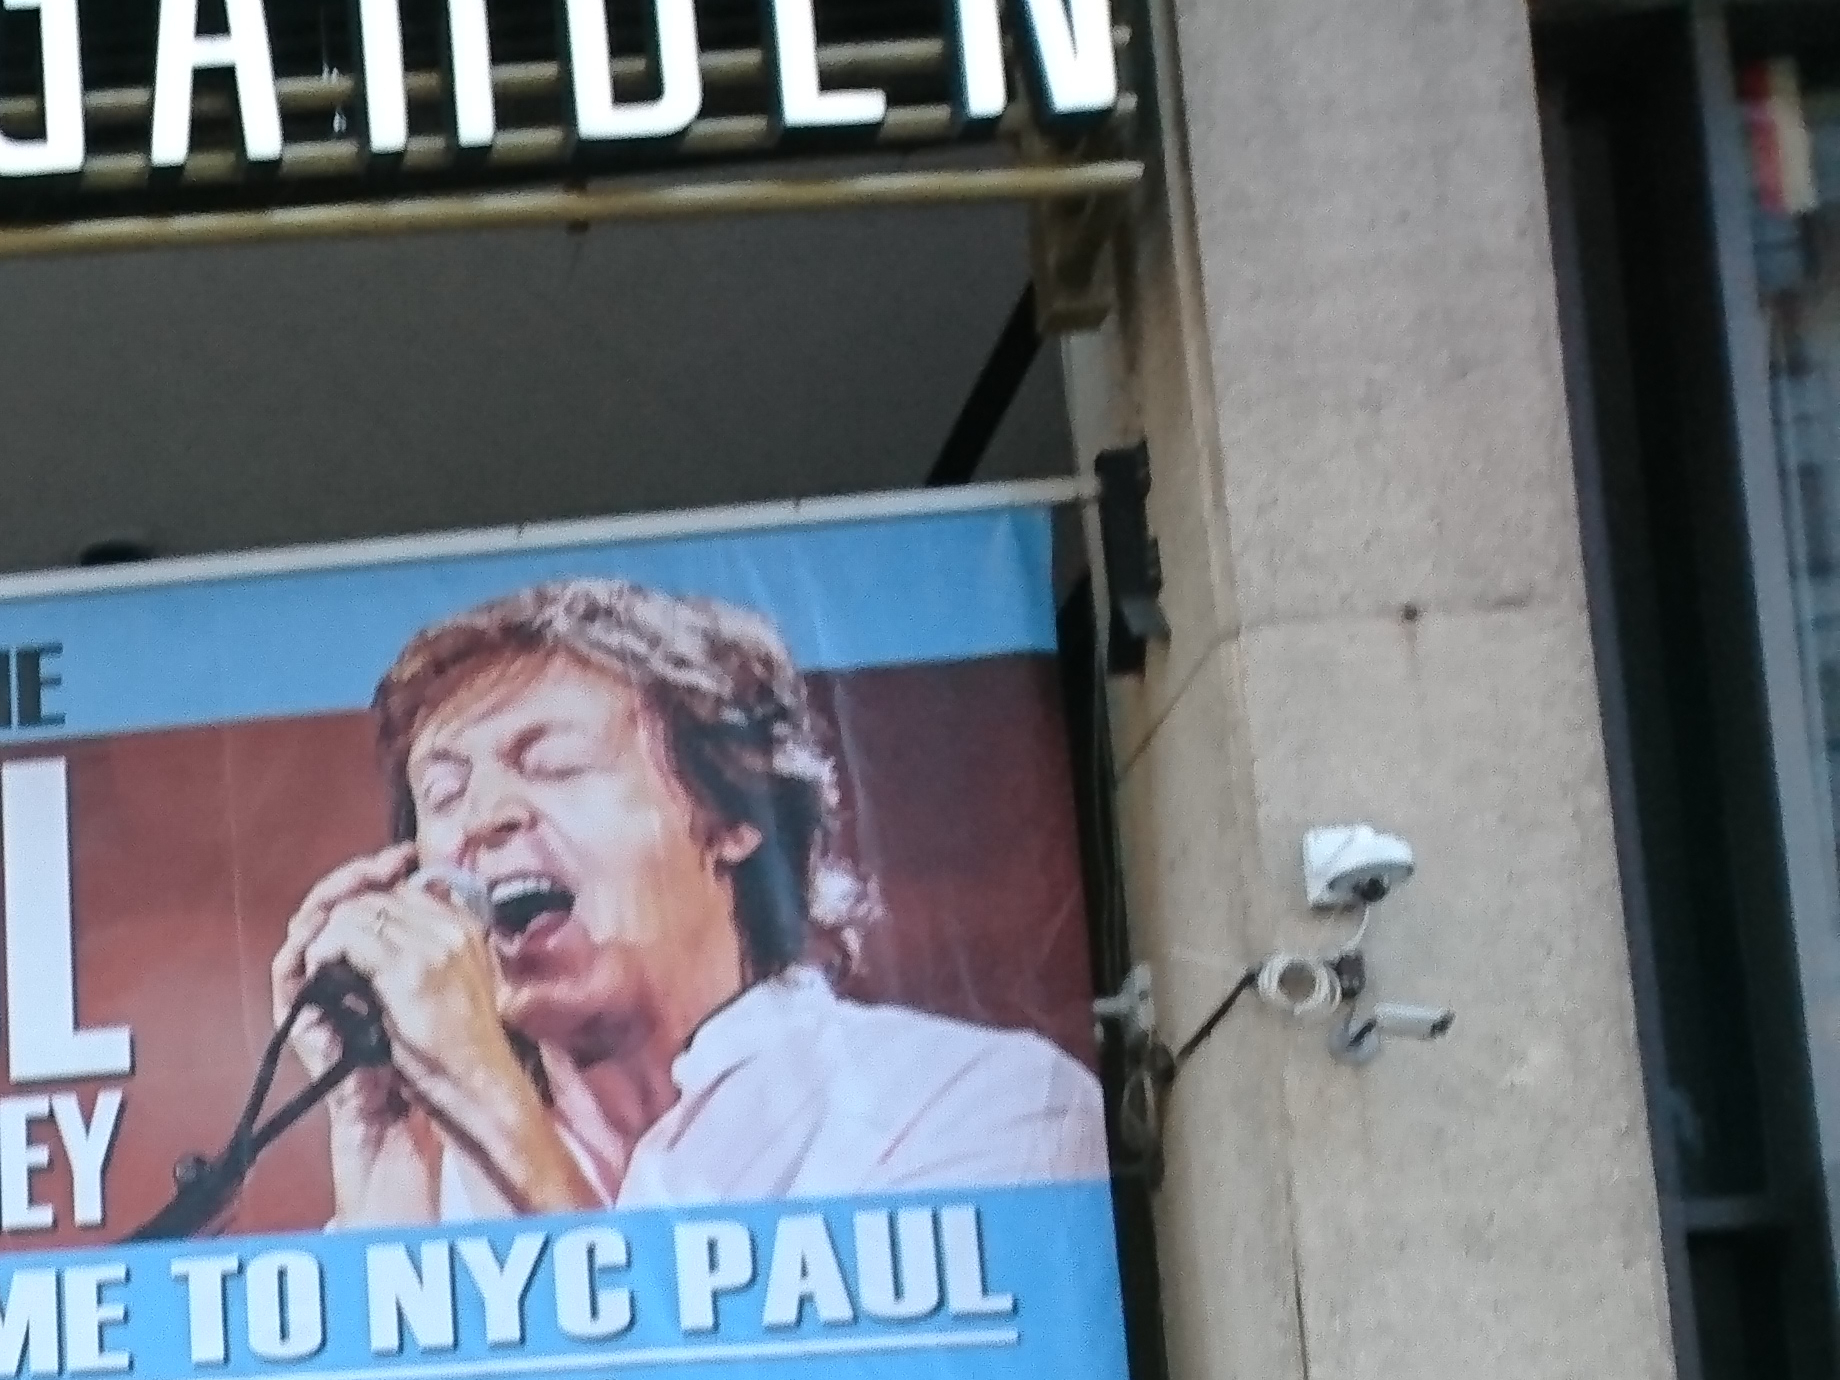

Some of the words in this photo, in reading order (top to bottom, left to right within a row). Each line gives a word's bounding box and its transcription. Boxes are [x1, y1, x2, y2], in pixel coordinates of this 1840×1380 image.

[171, 1250, 323, 1366] TO
[367, 1226, 634, 1351] NYC
[677, 1206, 1013, 1332] PAUL
